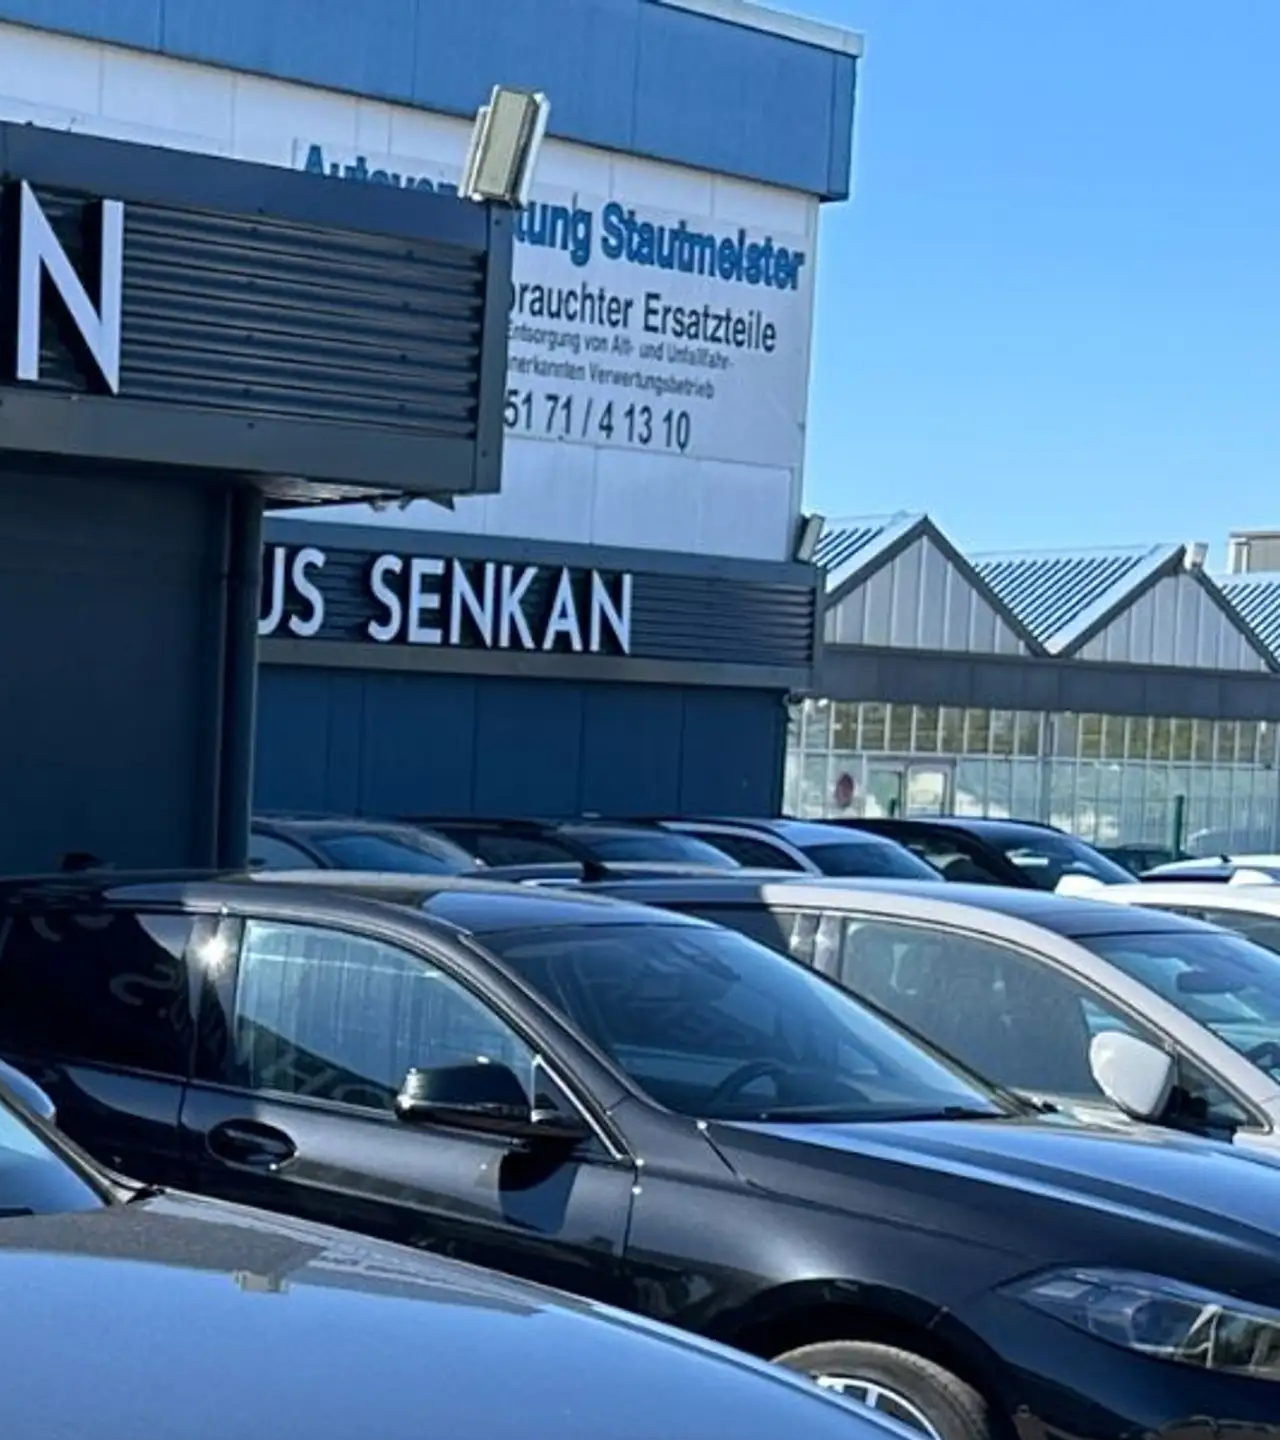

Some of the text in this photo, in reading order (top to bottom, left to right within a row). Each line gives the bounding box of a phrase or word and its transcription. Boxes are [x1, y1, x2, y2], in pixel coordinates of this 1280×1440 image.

[601, 202, 805, 291] Stautmeister
[584, 336, 609, 352] von
[639, 342, 663, 361] und
[643, 293, 777, 353] Ersatzteile
[545, 394, 572, 434] 71
[582, 396, 593, 438] /
[599, 400, 614, 439] 4
[624, 403, 653, 445] 13
[662, 408, 691, 452] 10
[367, 553, 633, 656] SENKAN
